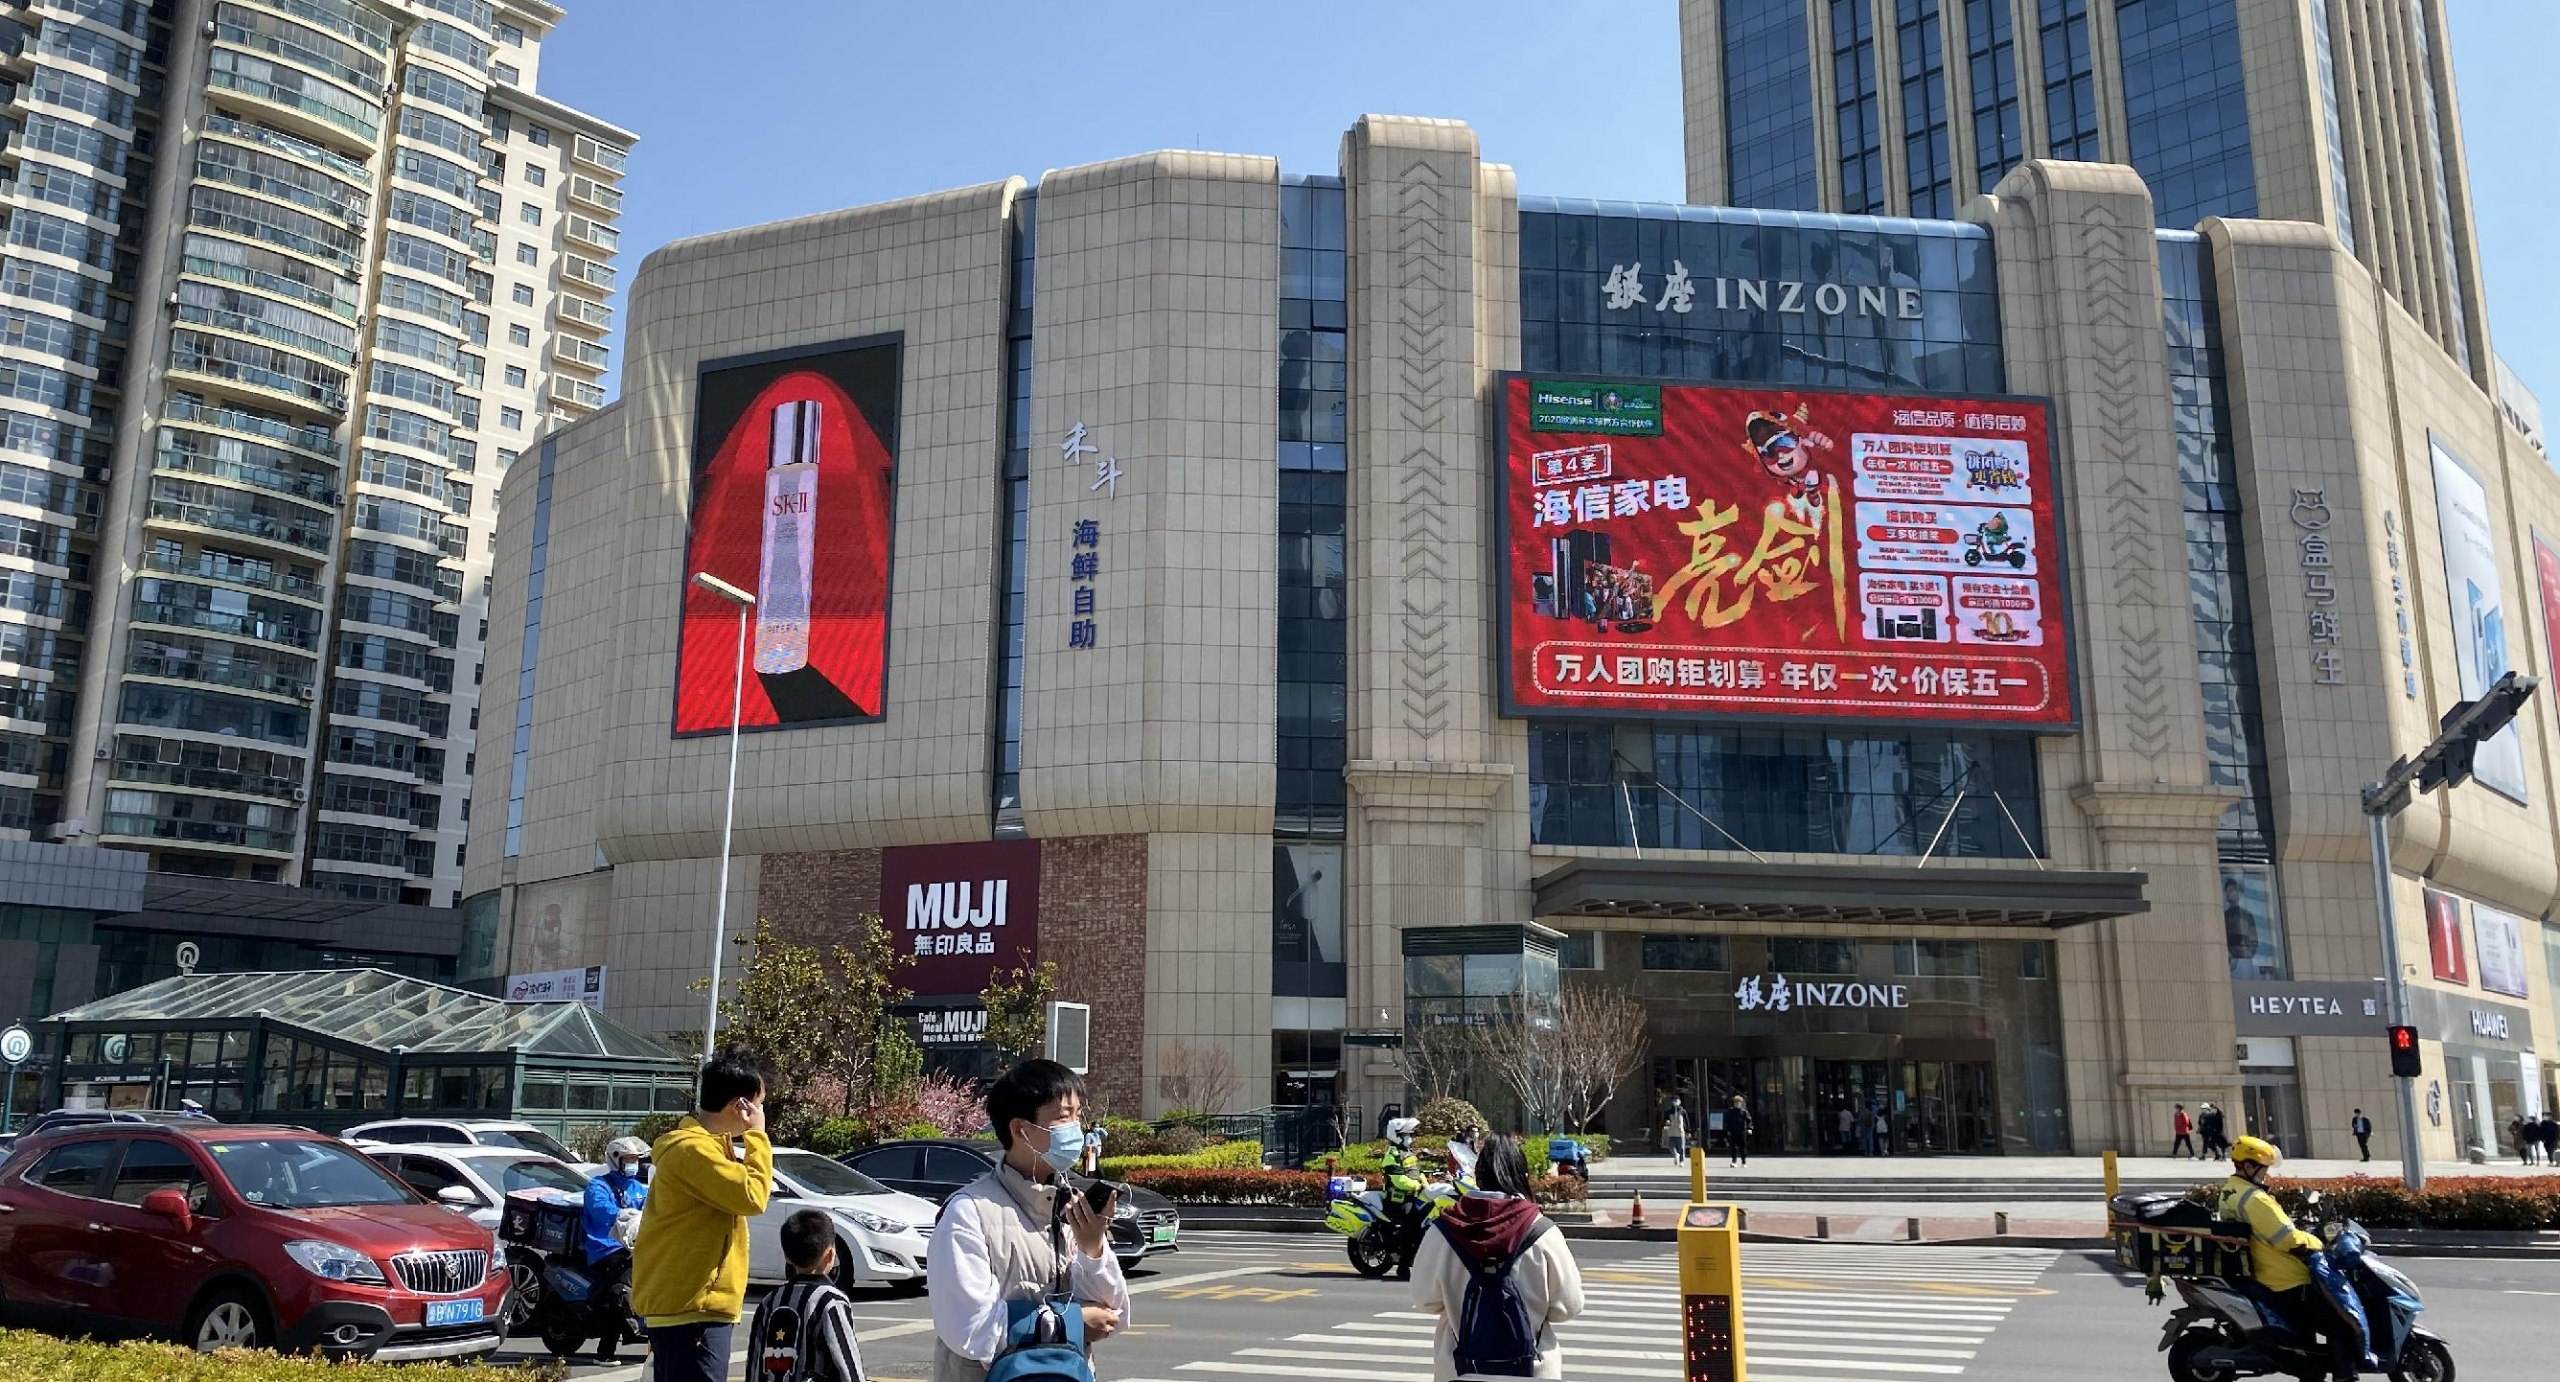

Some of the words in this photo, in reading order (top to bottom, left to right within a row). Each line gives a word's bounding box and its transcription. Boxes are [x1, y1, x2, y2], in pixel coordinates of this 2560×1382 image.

[1716, 278, 1923, 319] INZONE
[1538, 393, 1592, 406] Hisense
[1546, 454, 1597, 475] 第4季
[772, 492, 808, 516] SK-II
[1533, 473, 1691, 528] 海信家电
[1069, 519, 1100, 649] 海鲜自助
[2298, 534, 2345, 687] 盒马鲜生
[906, 879, 1008, 930] MUJI
[914, 932, 995, 956] 無印良品
[1796, 983, 1909, 1008] INZONE
[2250, 996, 2343, 1015] HEYTEA
[923, 1022, 943, 1033] Meal
[944, 1010, 988, 1032] MUJI
[2470, 1009, 2509, 1039] HUAWEI
